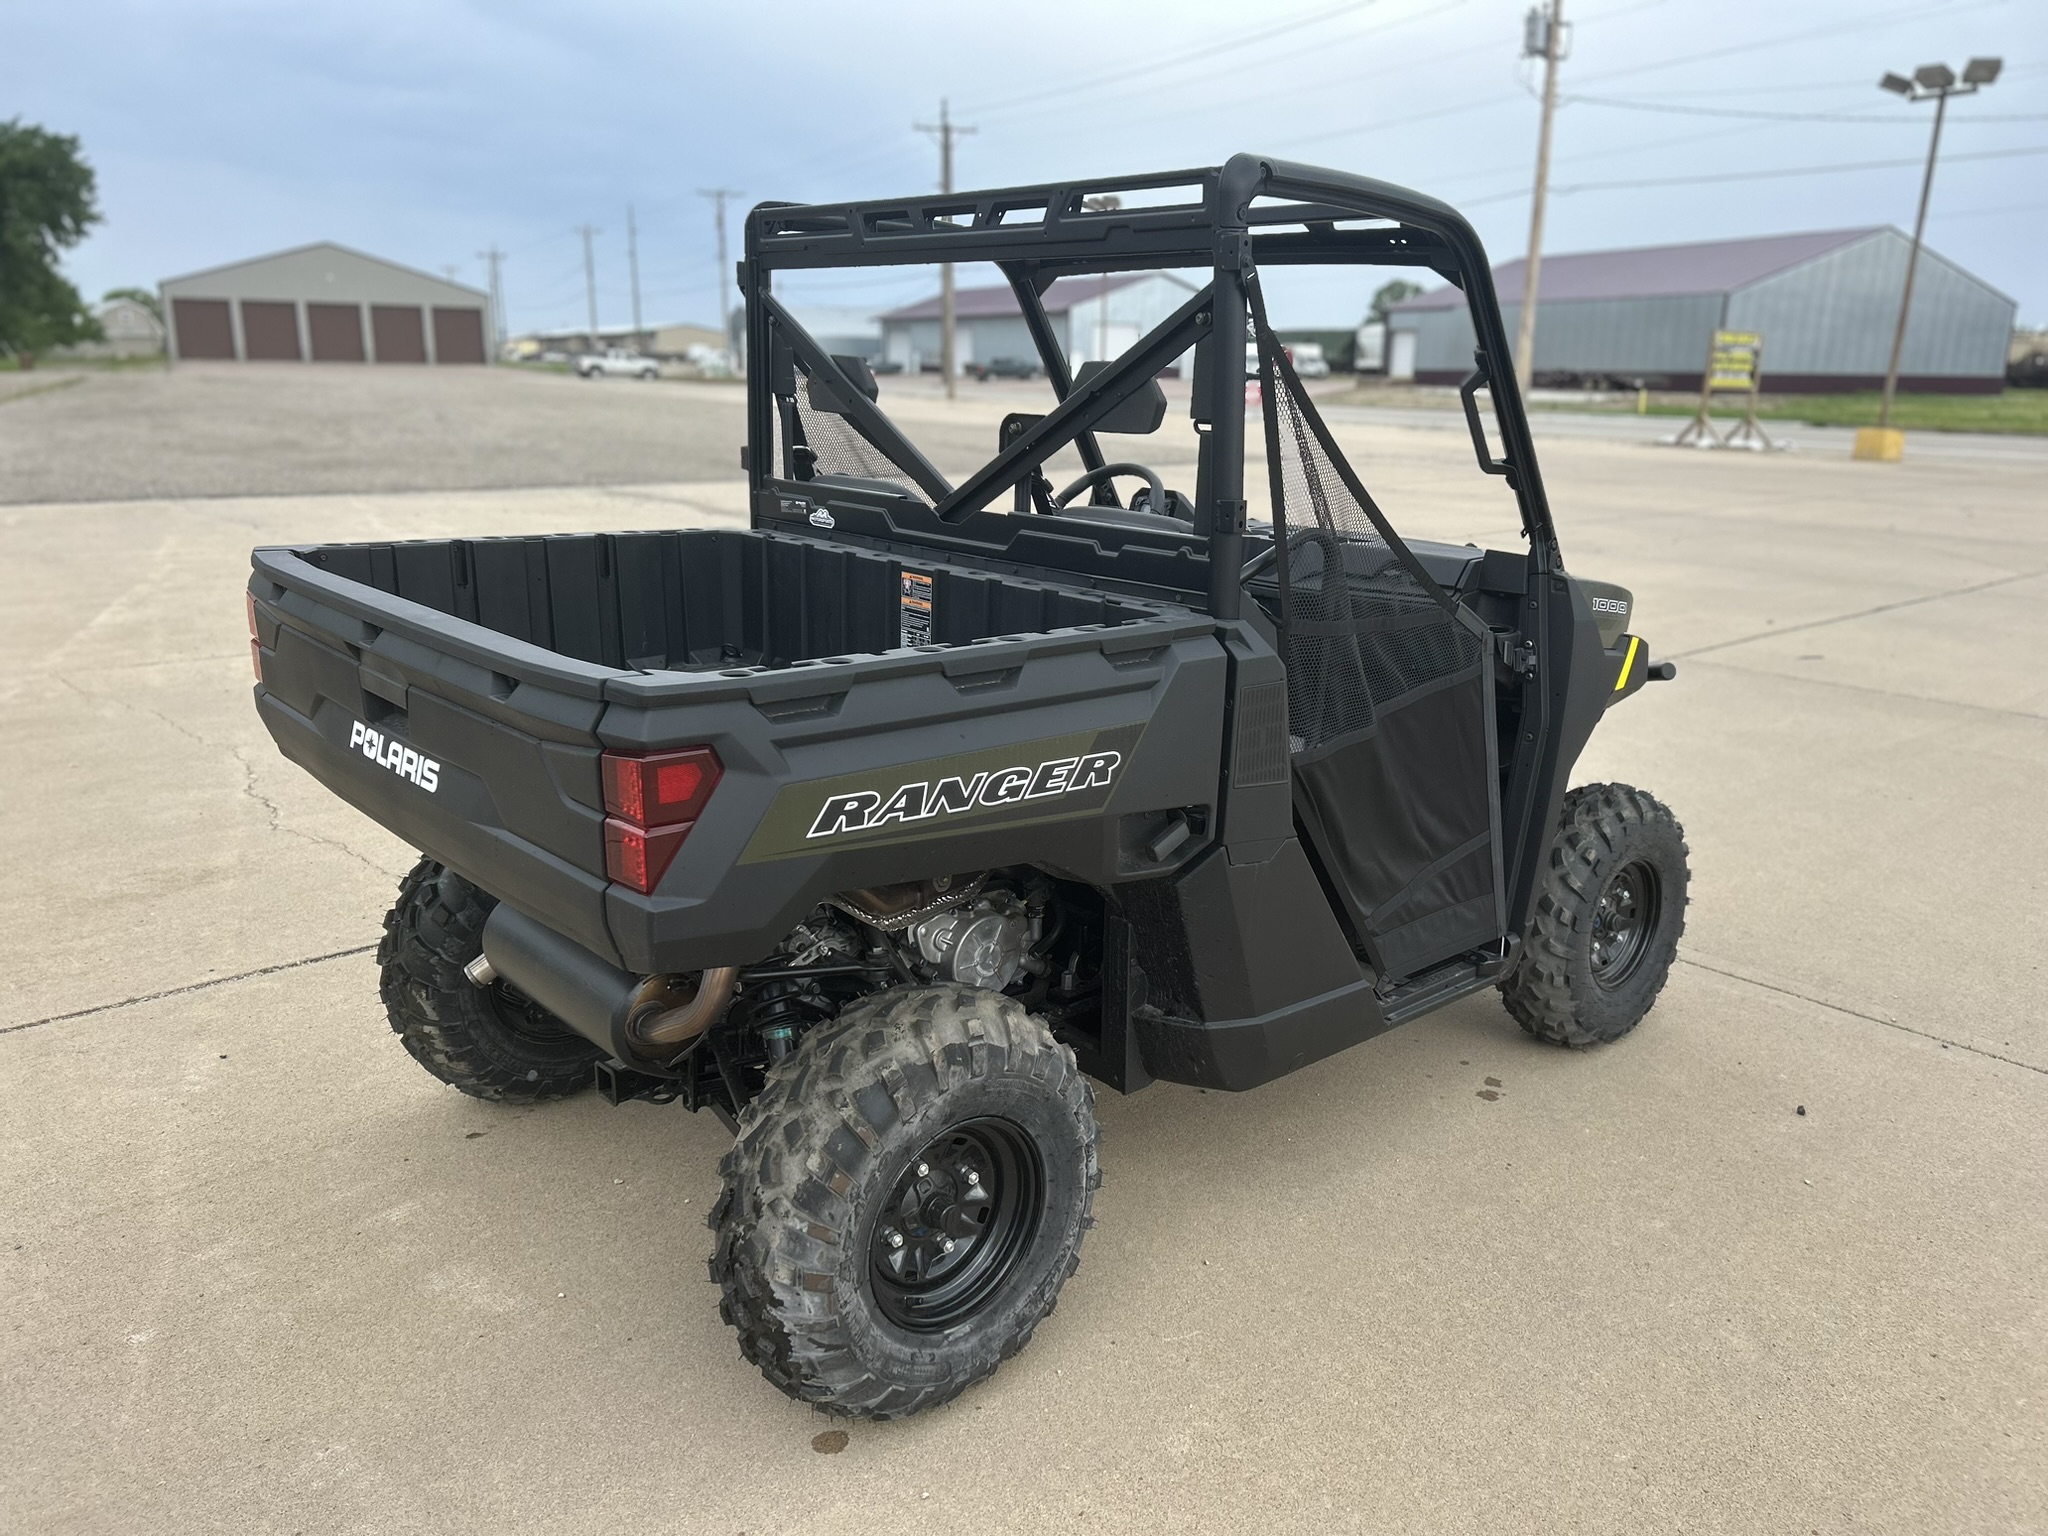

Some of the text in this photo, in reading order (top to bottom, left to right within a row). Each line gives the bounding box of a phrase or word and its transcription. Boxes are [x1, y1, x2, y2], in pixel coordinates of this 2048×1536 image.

[1593, 598, 1627, 614] 1000
[349, 720, 441, 793] POLARIS
[805, 750, 1121, 839] RANGER
